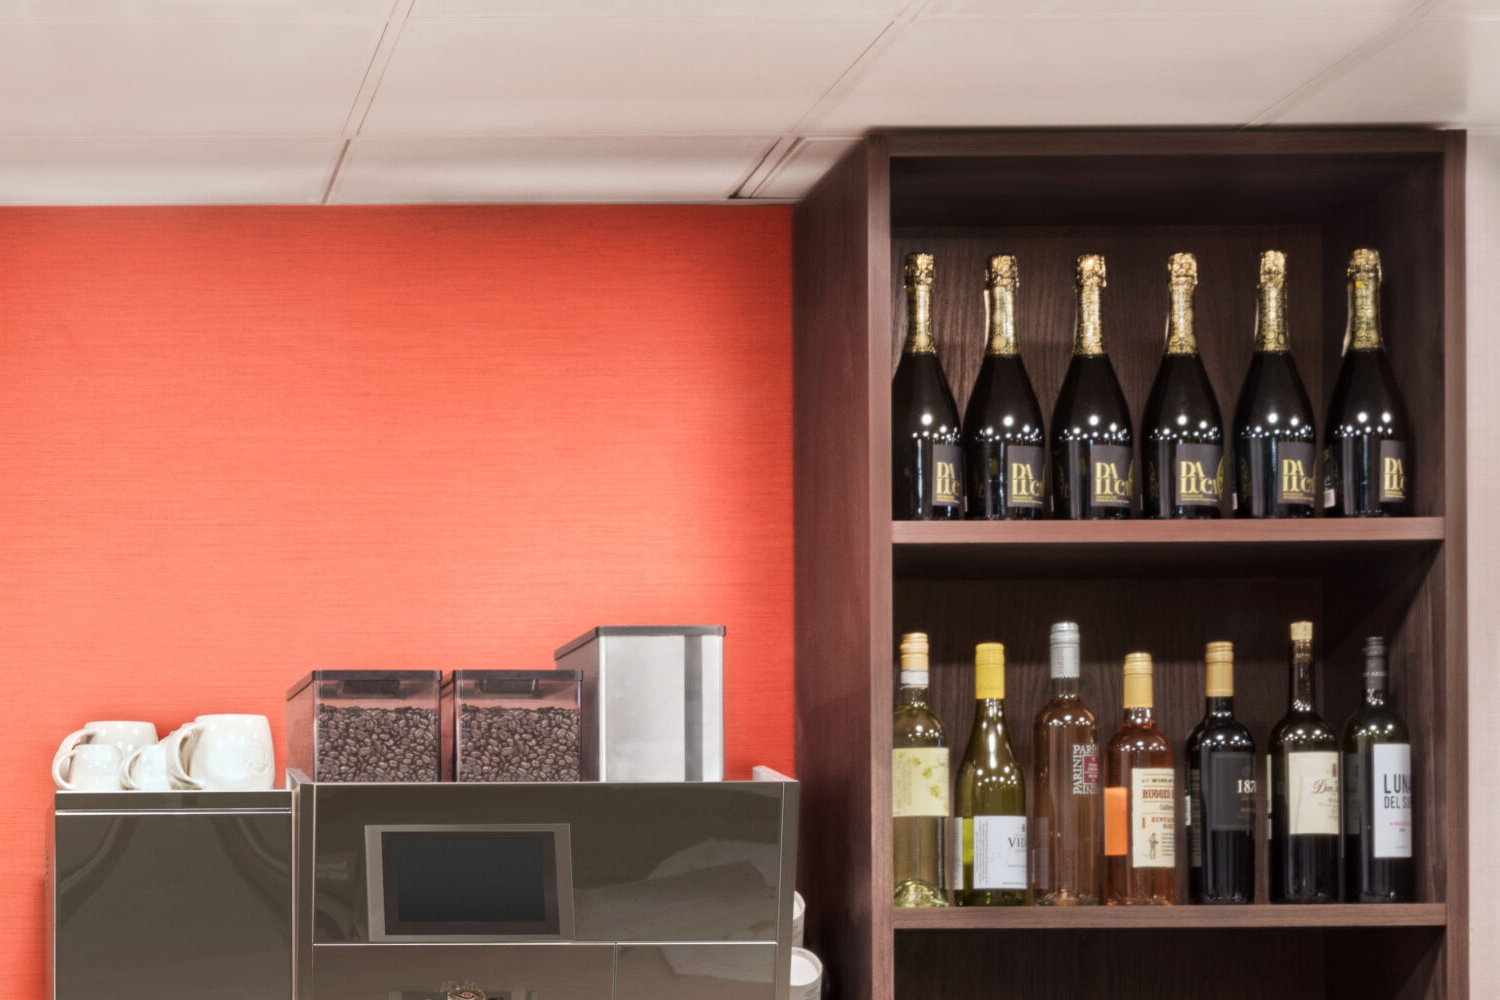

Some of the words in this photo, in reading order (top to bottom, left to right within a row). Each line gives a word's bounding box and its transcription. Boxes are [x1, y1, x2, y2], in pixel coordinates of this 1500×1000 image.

[1012, 462, 1034, 479] DA
[1096, 461, 1118, 479] DA
[1180, 460, 1205, 478] DA
[1282, 459, 1305, 476] DA
